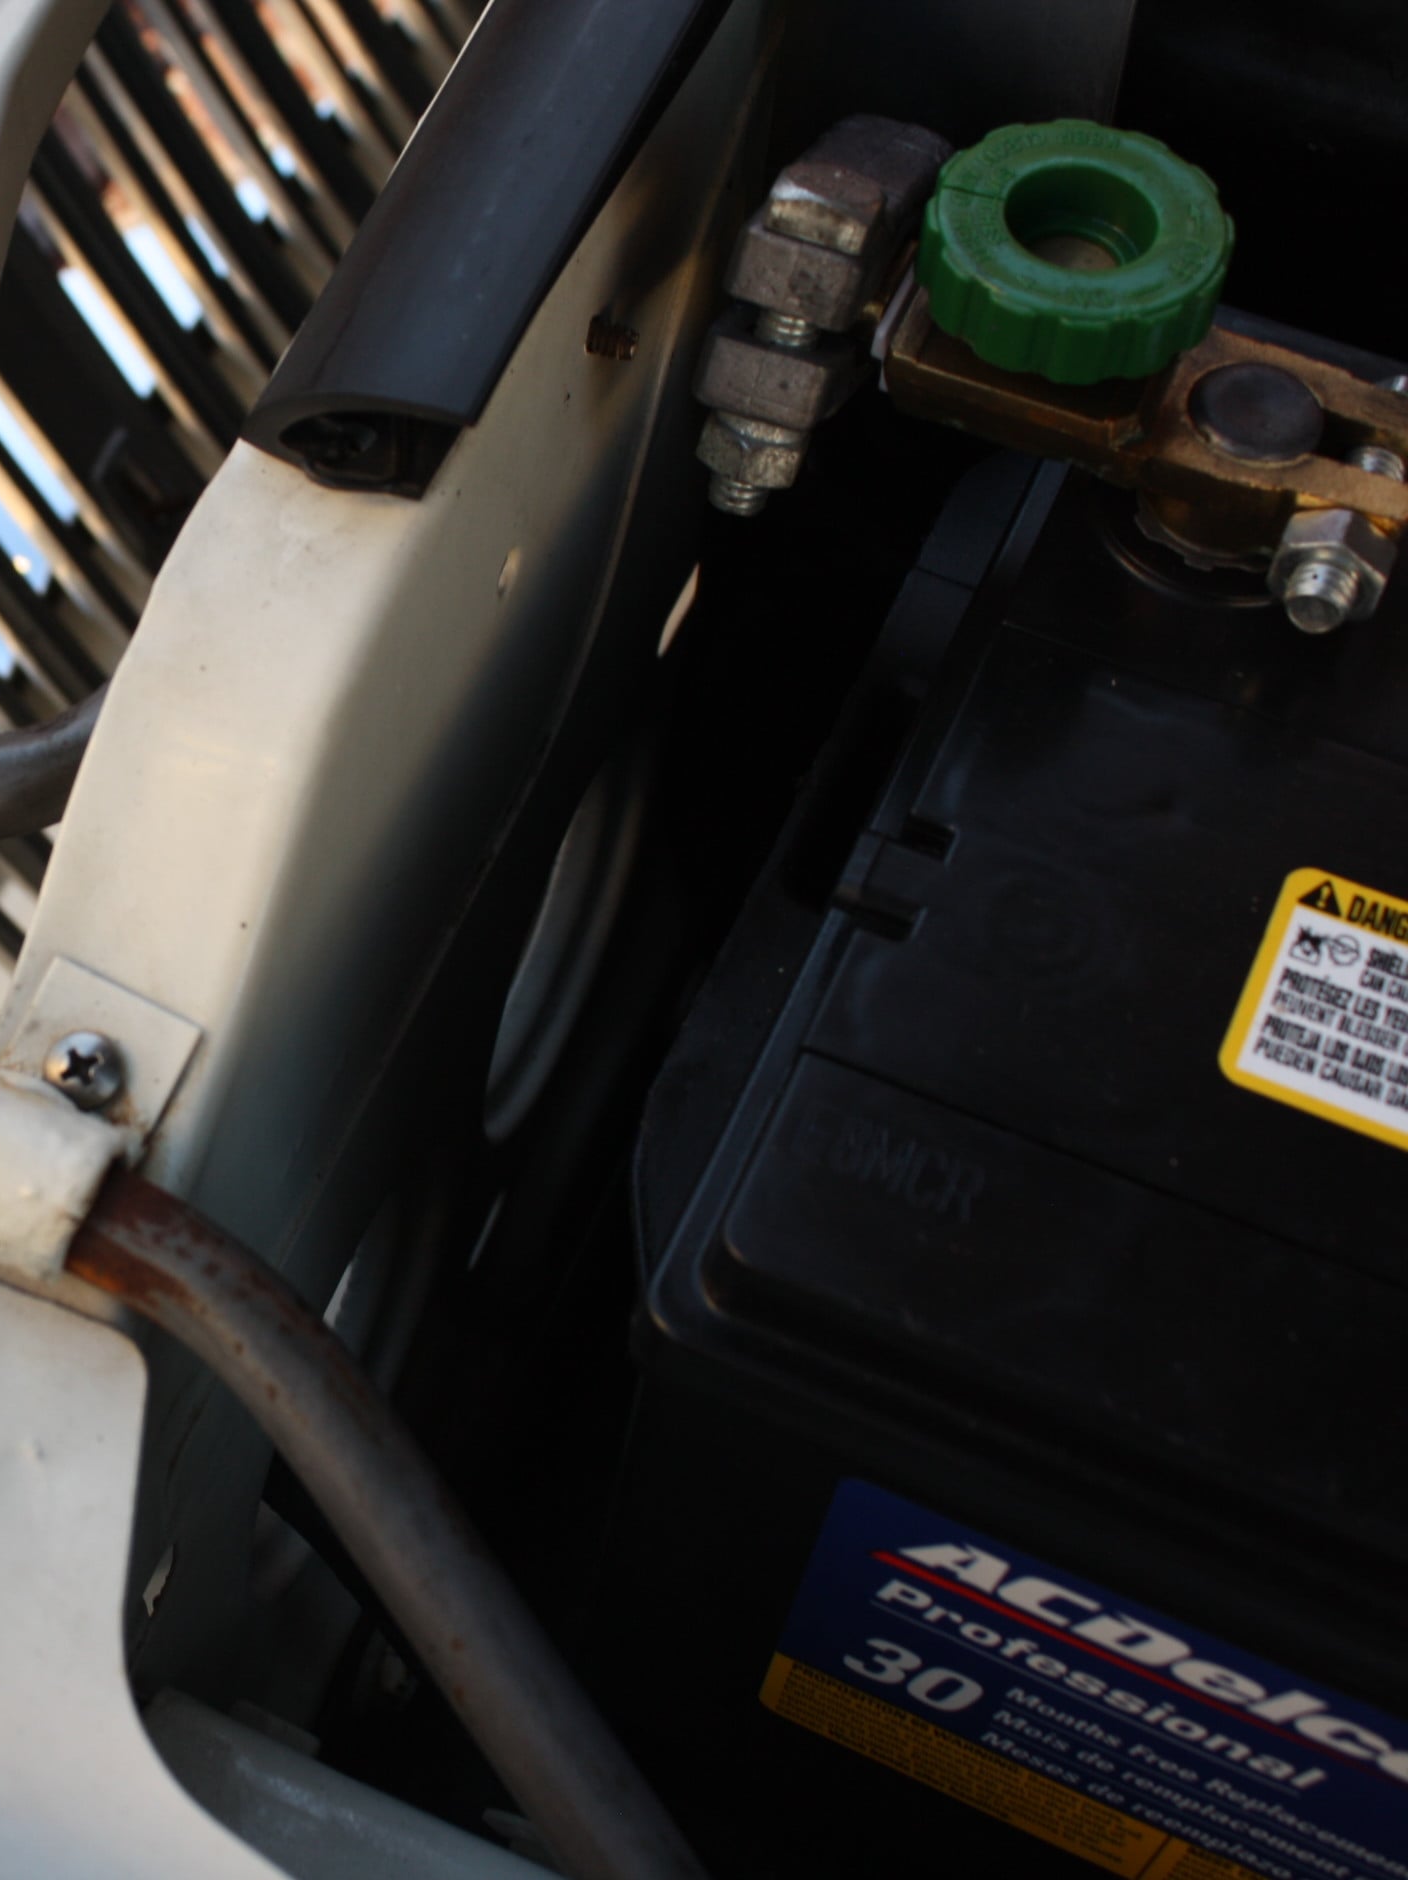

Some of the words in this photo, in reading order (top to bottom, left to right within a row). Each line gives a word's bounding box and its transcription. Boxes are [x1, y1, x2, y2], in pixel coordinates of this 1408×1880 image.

[1366, 947, 1408, 980] SHIEL
[843, 1638, 985, 1712] 30
[875, 1579, 1328, 1790] Professional
[981, 1731, 1081, 1785] Meses
[1087, 1783, 1125, 1805] de
[1131, 1803, 1292, 1879] reemplazo
[993, 1710, 1070, 1751] Mois
[1076, 1751, 1115, 1773] de
[1122, 1771, 1350, 1878] remplacement
[1006, 1687, 1122, 1748] Months
[1128, 1744, 1199, 1782] Free
[1205, 1778, 1408, 1879] Replacemen
